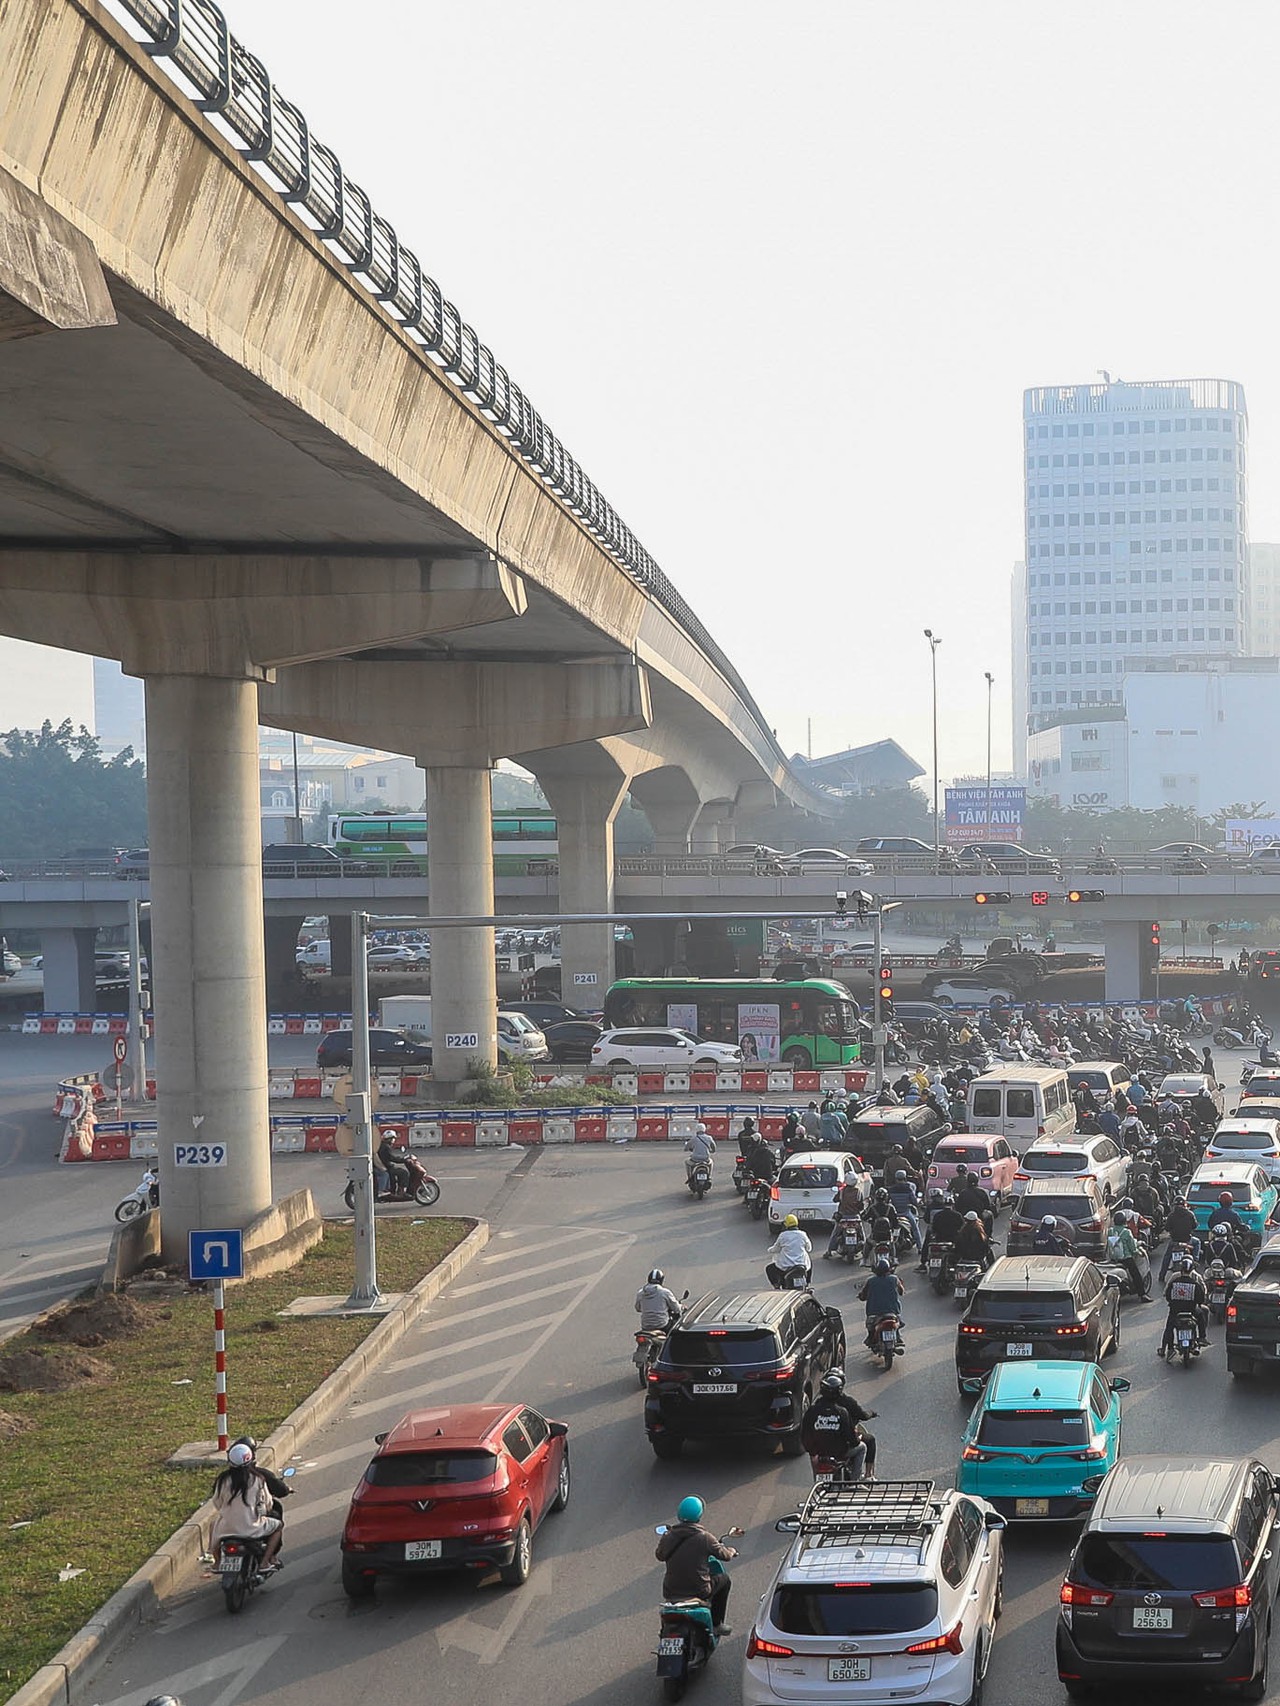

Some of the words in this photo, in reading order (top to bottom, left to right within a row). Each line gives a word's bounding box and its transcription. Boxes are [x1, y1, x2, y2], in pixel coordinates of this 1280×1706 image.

[1006, 790, 1023, 799] ANH
[958, 808, 987, 824] TÂM
[990, 810, 1020, 824] ANH
[1033, 892, 1047, 905] 62
[575, 974, 597, 983] P241
[447, 1035, 477, 1047] P240
[176, 1145, 225, 1164] P239
[1144, 1608, 1161, 1617] 89A
[1137, 1618, 1168, 1627] 256.63
[840, 1659, 859, 1669] 30H
[832, 1669, 866, 1680] 650.56
